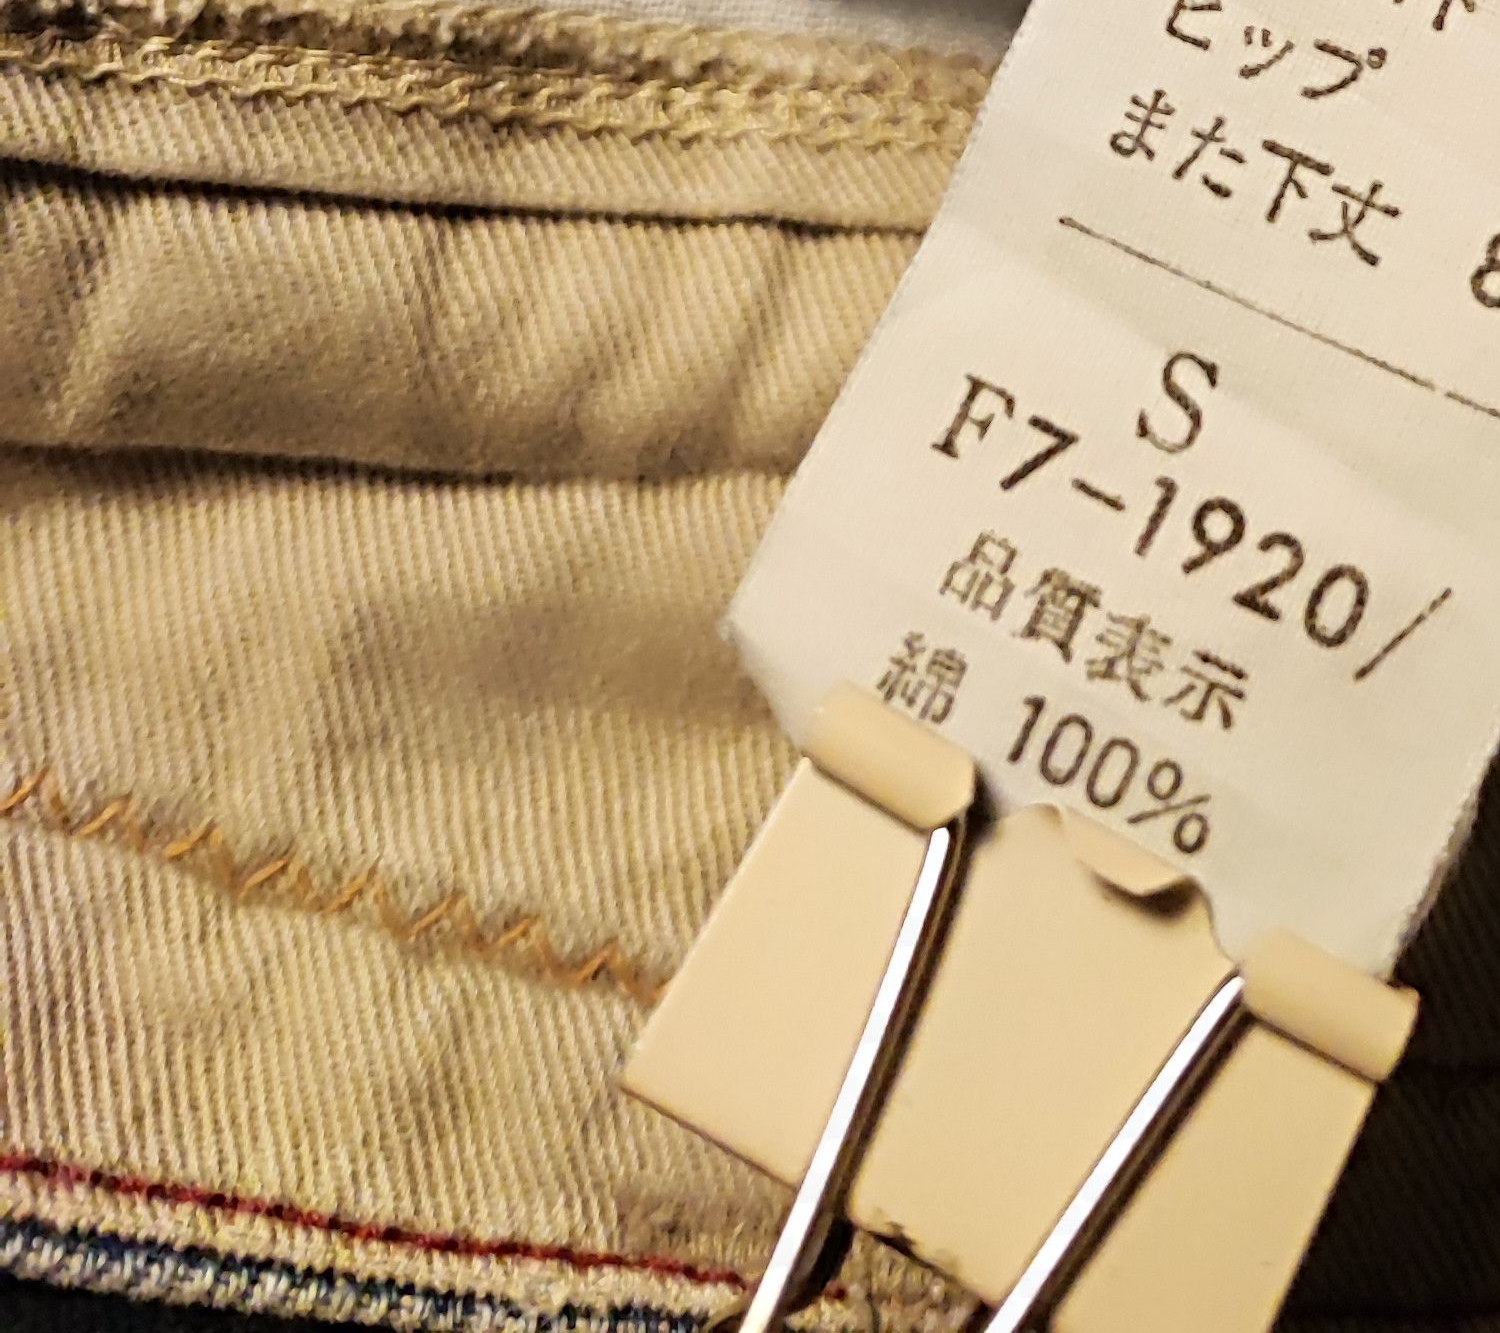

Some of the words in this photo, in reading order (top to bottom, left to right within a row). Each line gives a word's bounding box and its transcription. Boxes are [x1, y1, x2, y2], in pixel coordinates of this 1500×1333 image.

[1110, 90, 1401, 266] また下丈
[1137, 351, 1219, 454] S
[939, 530, 1247, 731] 品質表示
[874, 632, 969, 727] 綿
[1006, 695, 1211, 856] 100%
